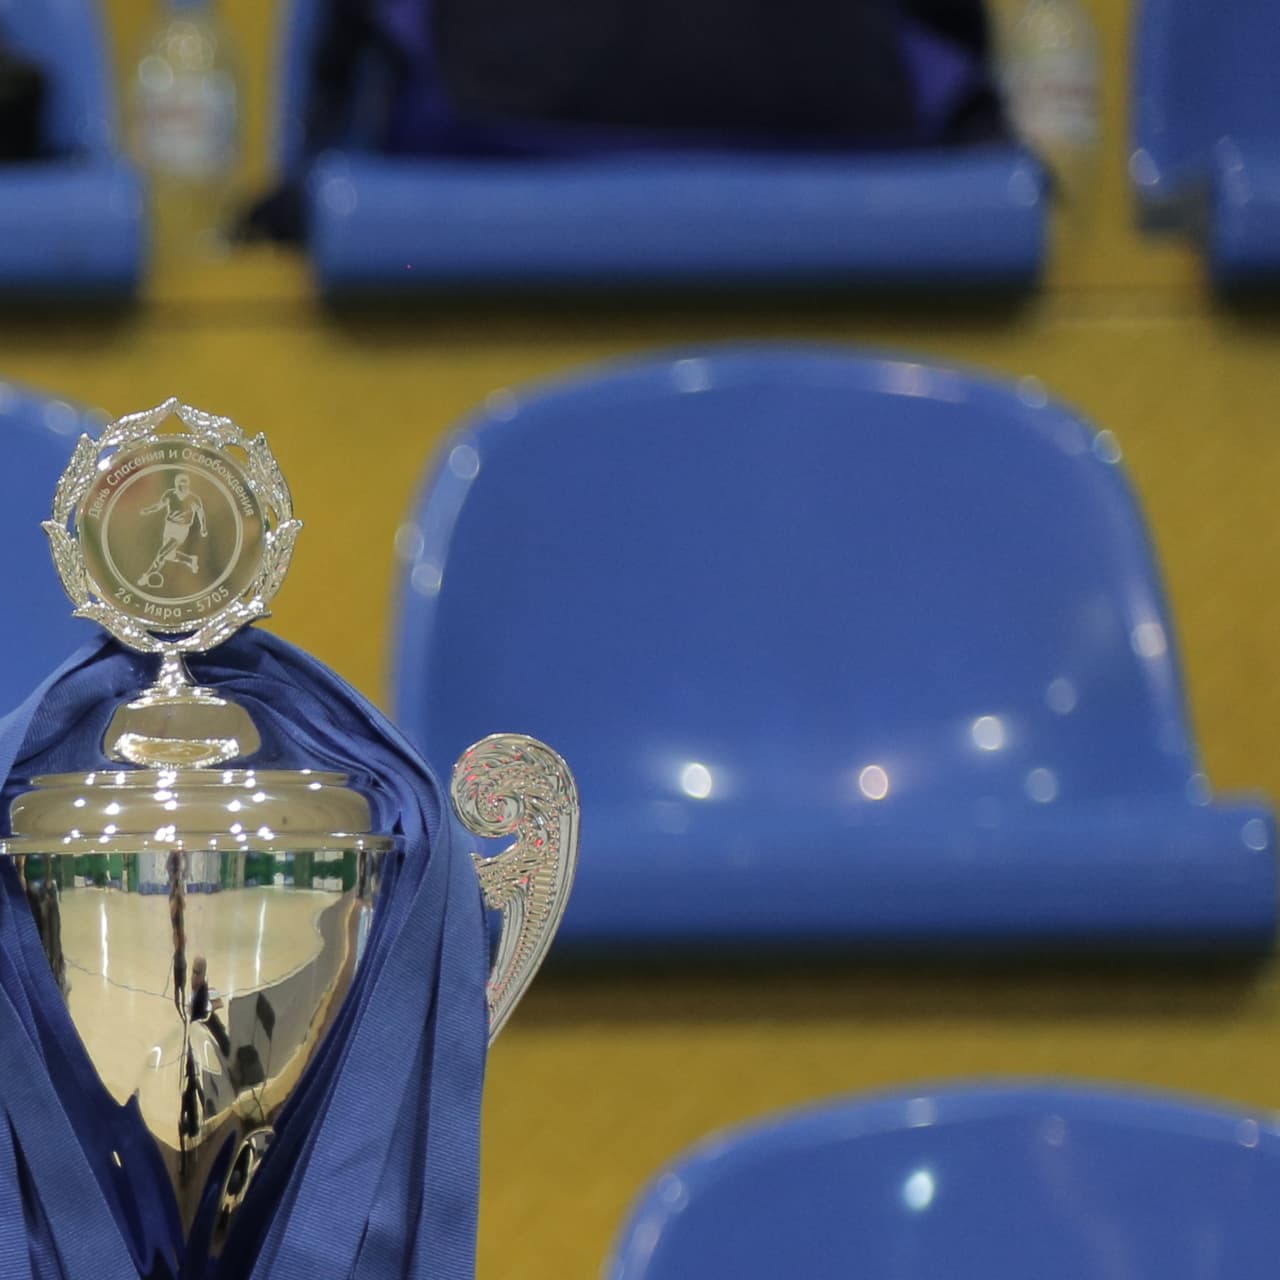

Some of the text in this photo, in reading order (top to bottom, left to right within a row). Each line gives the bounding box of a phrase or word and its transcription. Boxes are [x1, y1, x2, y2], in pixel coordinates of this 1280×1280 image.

[88, 447, 255, 519] День Спасения и Освобождения
[114, 586, 131, 604] 26
[144, 601, 181, 618] Ияра
[197, 585, 230, 613] 5705
